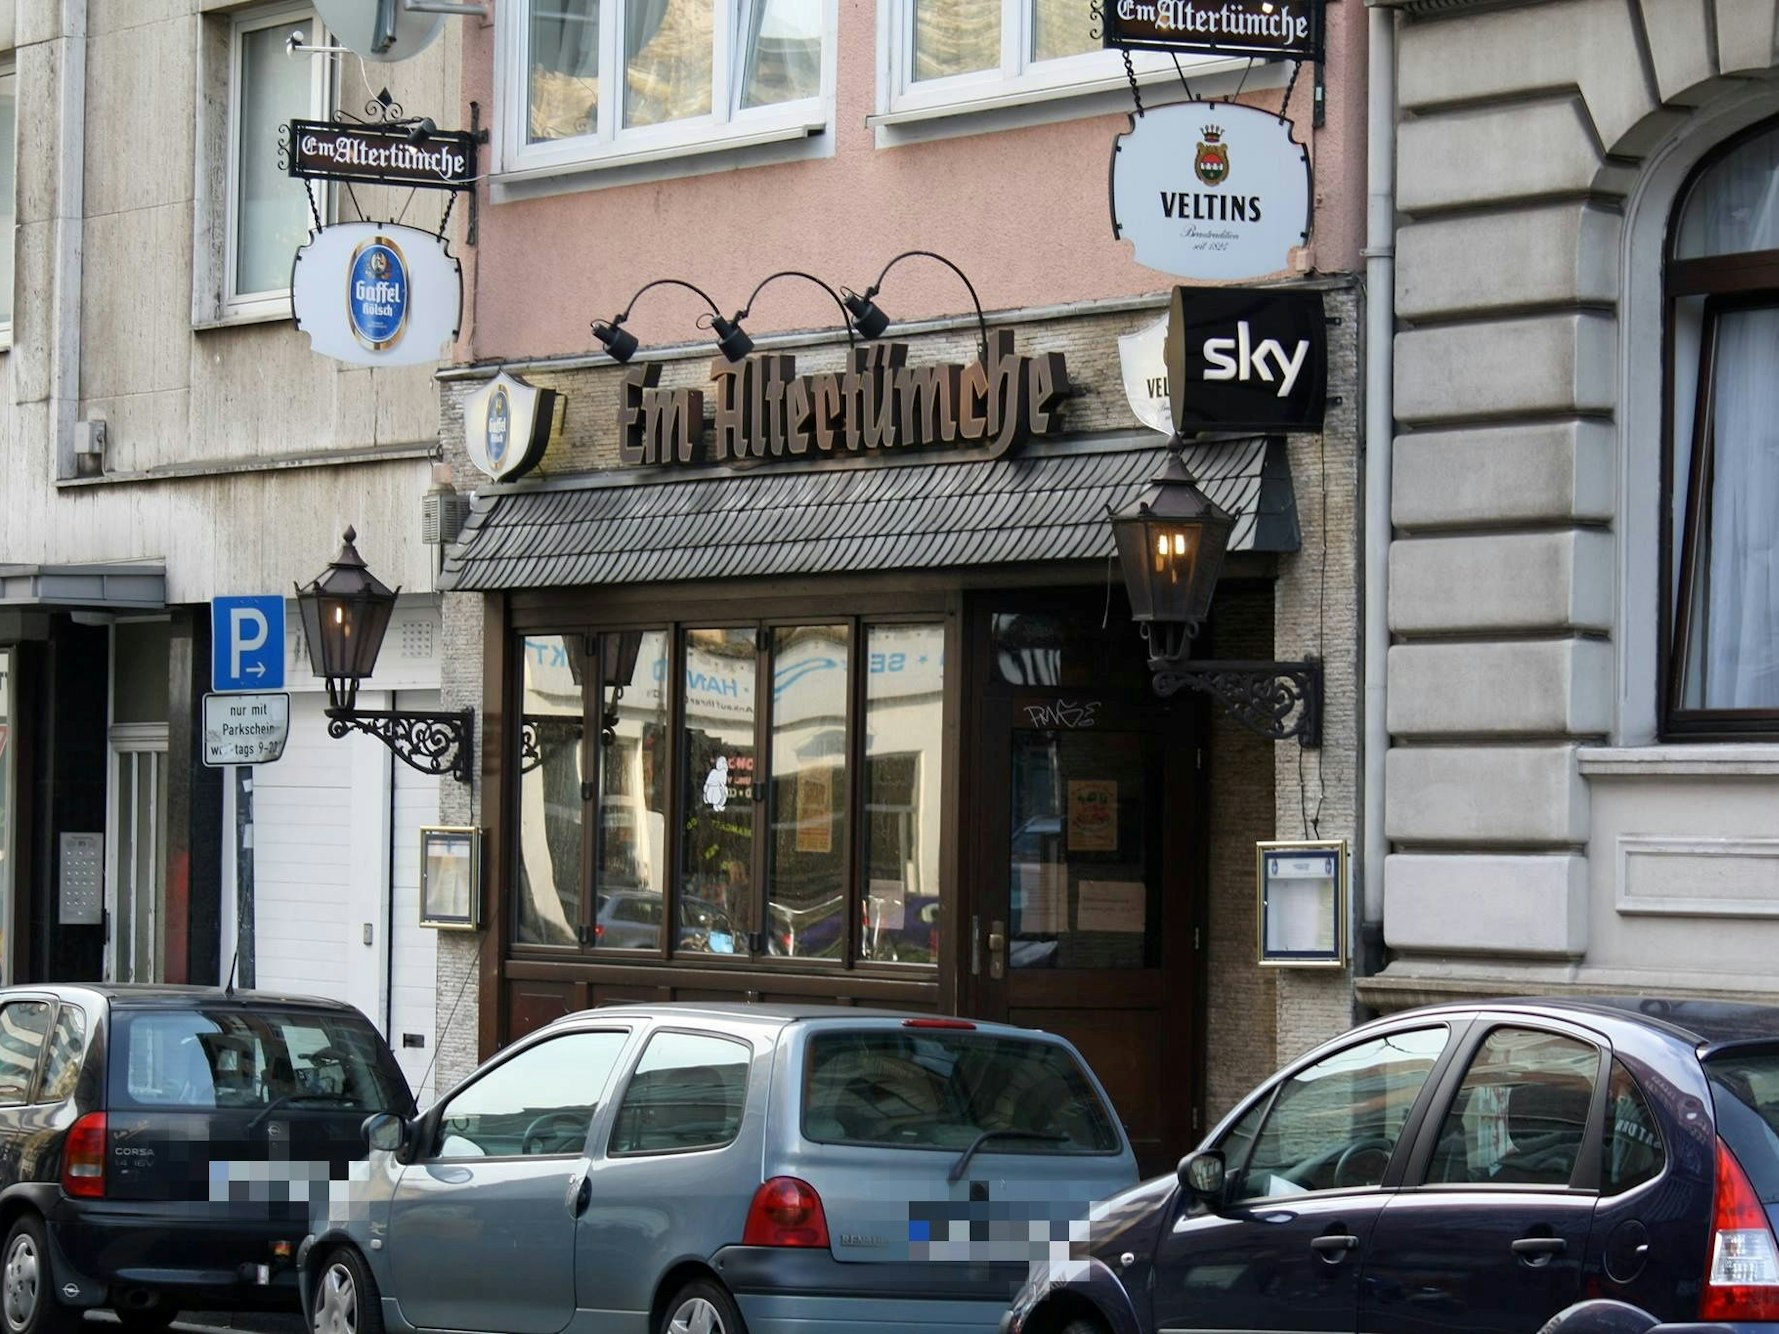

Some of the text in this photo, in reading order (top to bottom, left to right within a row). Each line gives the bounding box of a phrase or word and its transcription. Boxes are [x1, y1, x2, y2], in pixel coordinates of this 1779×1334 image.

[1160, 191, 1262, 223] VELTINS
[356, 280, 402, 304] Gaffel
[1203, 321, 1310, 397] sky
[617, 331, 1064, 464] Em Altertümche
[230, 608, 268, 679] P
[230, 703, 268, 716] nur mit
[222, 723, 275, 736] Parkschein
[115, 1147, 155, 1156] CORSA
